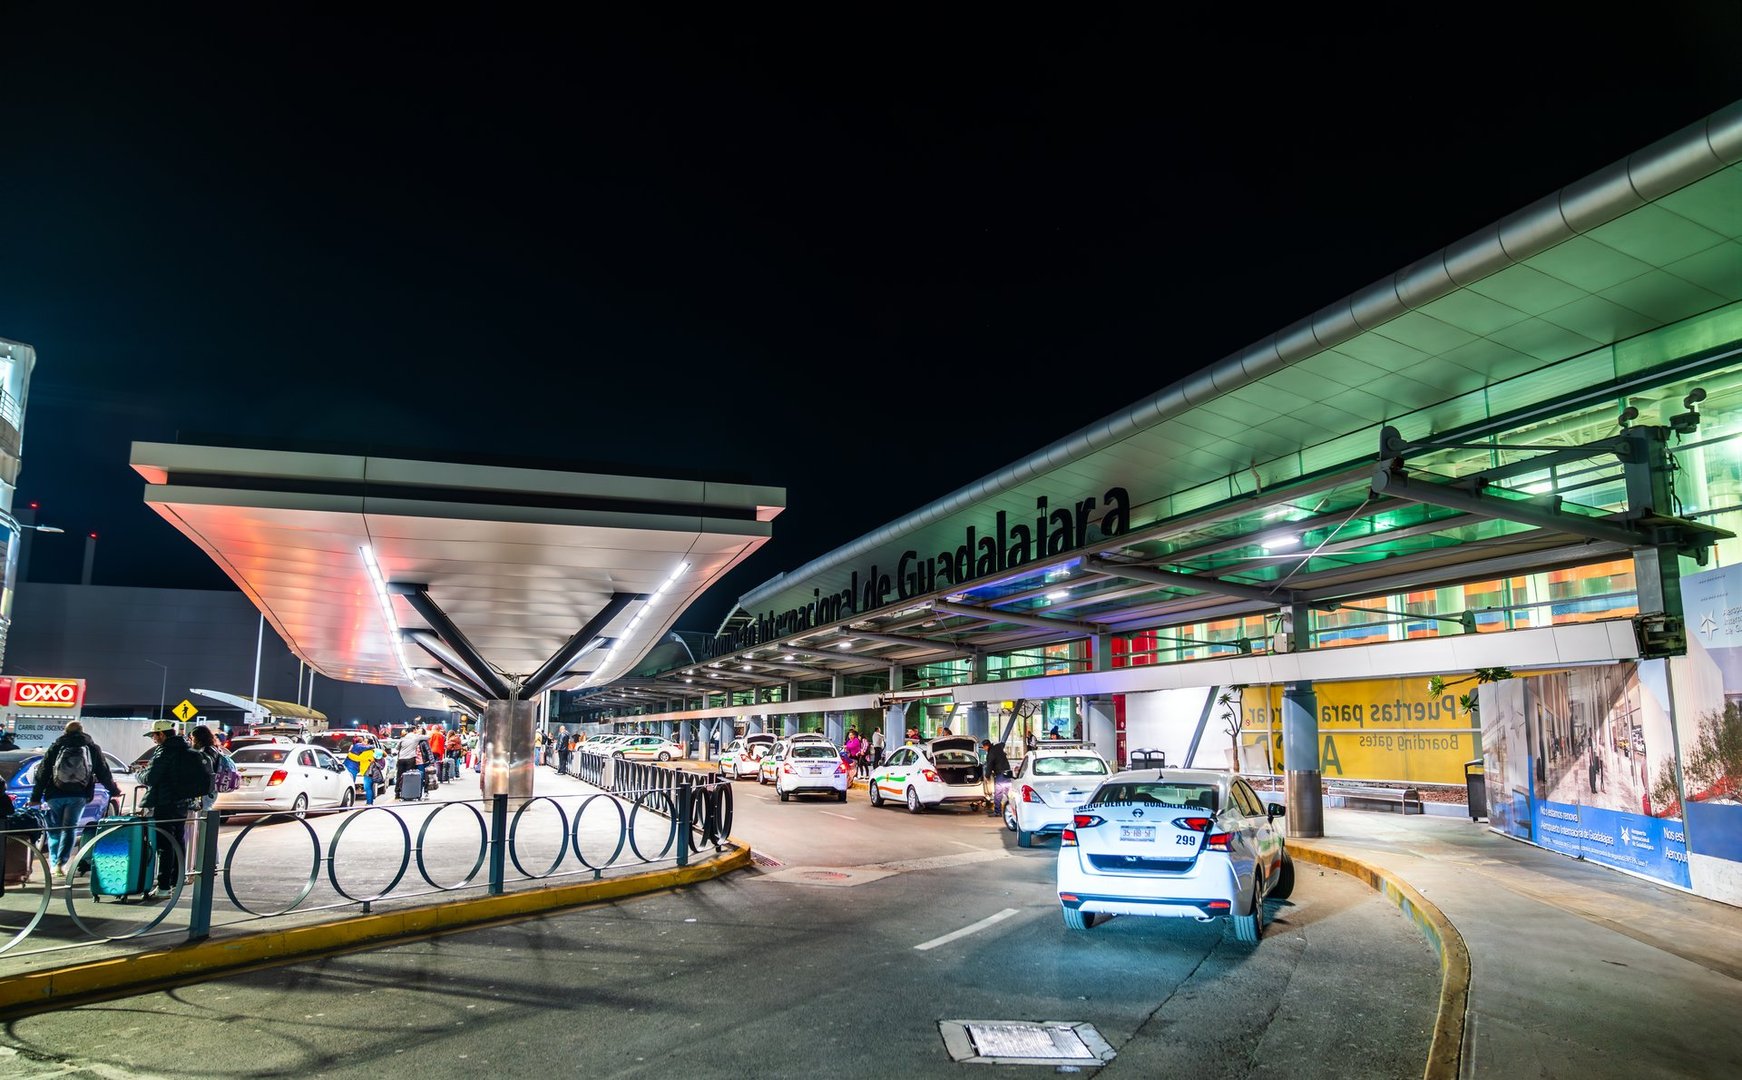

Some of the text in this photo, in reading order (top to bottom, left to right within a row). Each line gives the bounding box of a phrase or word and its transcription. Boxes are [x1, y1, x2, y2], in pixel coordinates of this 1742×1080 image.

[759, 570, 858, 645] Internacional
[863, 564, 891, 604] de
[898, 487, 1130, 601] Guadalajara
[19, 683, 74, 702] OXXO
[1175, 834, 1196, 846] 299
[1663, 827, 1675, 840] Nos
